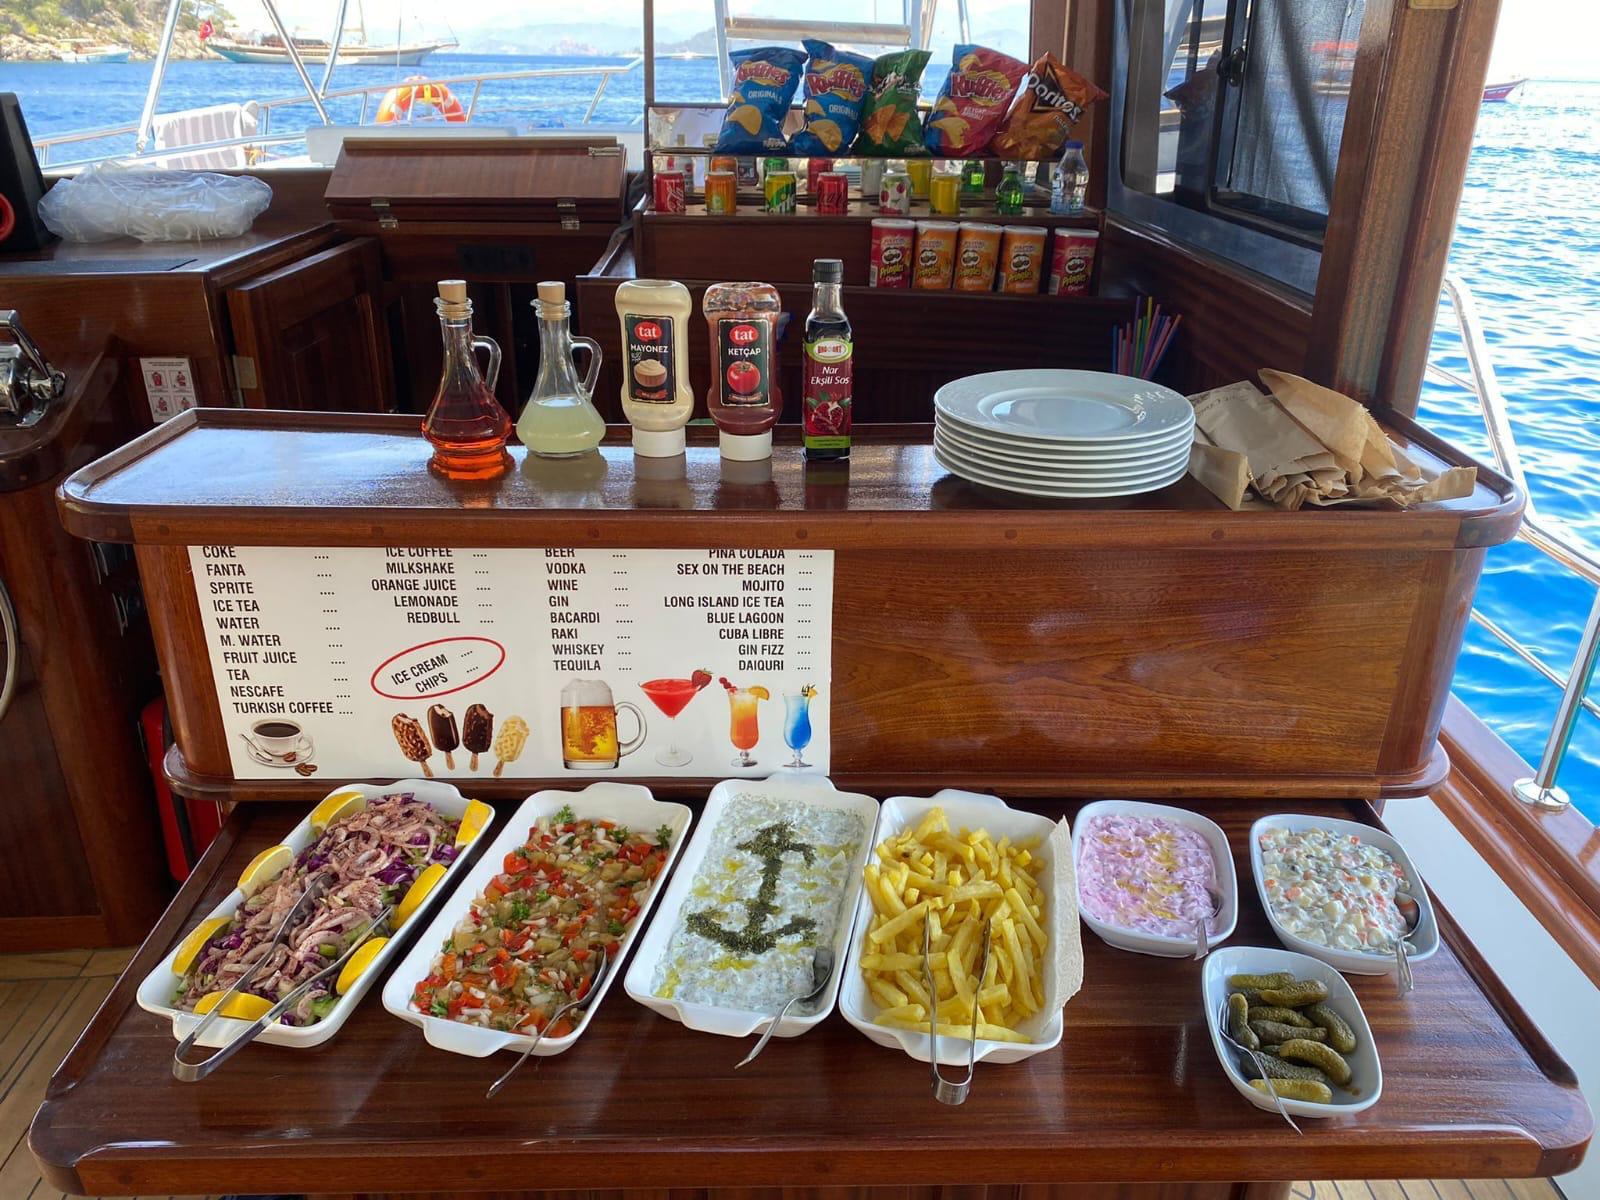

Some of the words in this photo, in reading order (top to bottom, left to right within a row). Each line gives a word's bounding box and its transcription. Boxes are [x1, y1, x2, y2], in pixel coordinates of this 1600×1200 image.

[1028, 73, 1082, 121] Doritos
[638, 326, 658, 338] tat
[734, 330, 754, 342] tat
[630, 343, 669, 354] MAYONEZ
[727, 347, 761, 357] KETÇAP
[822, 366, 840, 375] Nar
[811, 376, 833, 386] Ekşili
[835, 376, 850, 385] Sos
[203, 546, 236, 558] COKE
[386, 548, 405, 558] ICE
[408, 548, 453, 558] COFFEE
[545, 549, 575, 558] BEER
[207, 564, 245, 576] FANTA
[386, 563, 454, 573] MILKSHAKE
[546, 563, 585, 574] VODKA
[677, 564, 698, 574] SEX
[703, 564, 718, 575] ON
[722, 564, 743, 574] THE
[748, 564, 784, 575] BEACH
[210, 582, 253, 594] SPRITE
[372, 579, 419, 590] ORANGE
[424, 579, 456, 590] JUICE
[548, 580, 578, 590] WINE
[743, 580, 784, 591] MOJITO
[213, 600, 234, 611] ICE
[238, 600, 260, 612] TEA
[394, 596, 458, 607] LEMONADE
[549, 596, 568, 606] GIN
[665, 596, 694, 607] LONG
[699, 597, 738, 607] ISLAND
[743, 597, 760, 607] ICE
[764, 597, 784, 607] TEA
[407, 612, 460, 623] REDBULL
[551, 612, 599, 623] BACARDI
[708, 613, 734, 623] BLUE
[739, 613, 783, 623] LAGOON
[216, 618, 259, 629] WATER
[552, 629, 577, 639] RAKI
[720, 629, 748, 639] CUBA
[753, 629, 783, 639] LIBRE
[220, 635, 235, 646] M.
[238, 635, 280, 646] WATER
[553, 644, 604, 655] WHISKEY
[739, 645, 757, 655] GIN
[762, 645, 784, 655] FIZZ
[224, 652, 258, 663] FRUIT
[263, 652, 297, 663] JUICE
[391, 671, 410, 686] ICE
[408, 654, 448, 678] CREAM
[554, 660, 600, 670] TEQUILA
[739, 660, 783, 670] DAIQURI
[227, 669, 249, 680] TEA
[415, 673, 448, 694] CHIPS
[231, 686, 284, 697] NESCAFE
[233, 703, 285, 713] TURKISH
[289, 702, 333, 713] COFFEE
